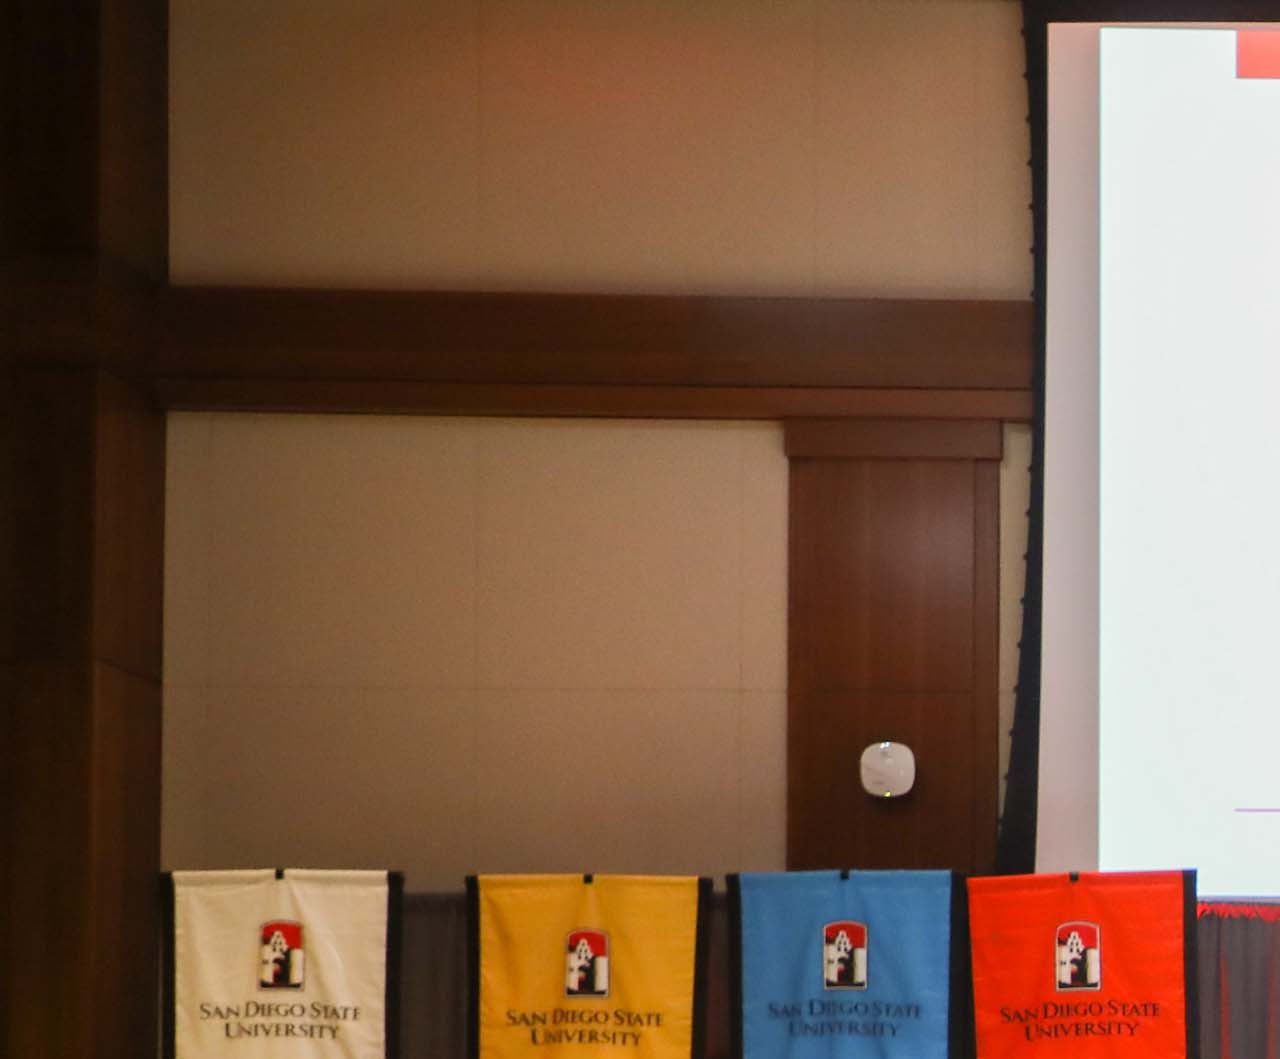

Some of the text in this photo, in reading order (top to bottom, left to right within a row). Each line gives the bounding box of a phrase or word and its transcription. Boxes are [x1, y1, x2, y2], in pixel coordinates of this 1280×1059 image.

[200, 1001, 361, 1021] SAN DIEGO STATE
[506, 1008, 665, 1028] SAN DIEGO STATE
[767, 1000, 922, 1019] SAN DIEGO STATE
[1000, 1000, 1160, 1024] SAN DIEGO STATE
[224, 1022, 341, 1040] UNIVERSITY
[530, 1028, 642, 1047] UNIVERSITY
[788, 1020, 901, 1038] UNIVERSITY
[1023, 1020, 1140, 1042] UNIVERSITY
